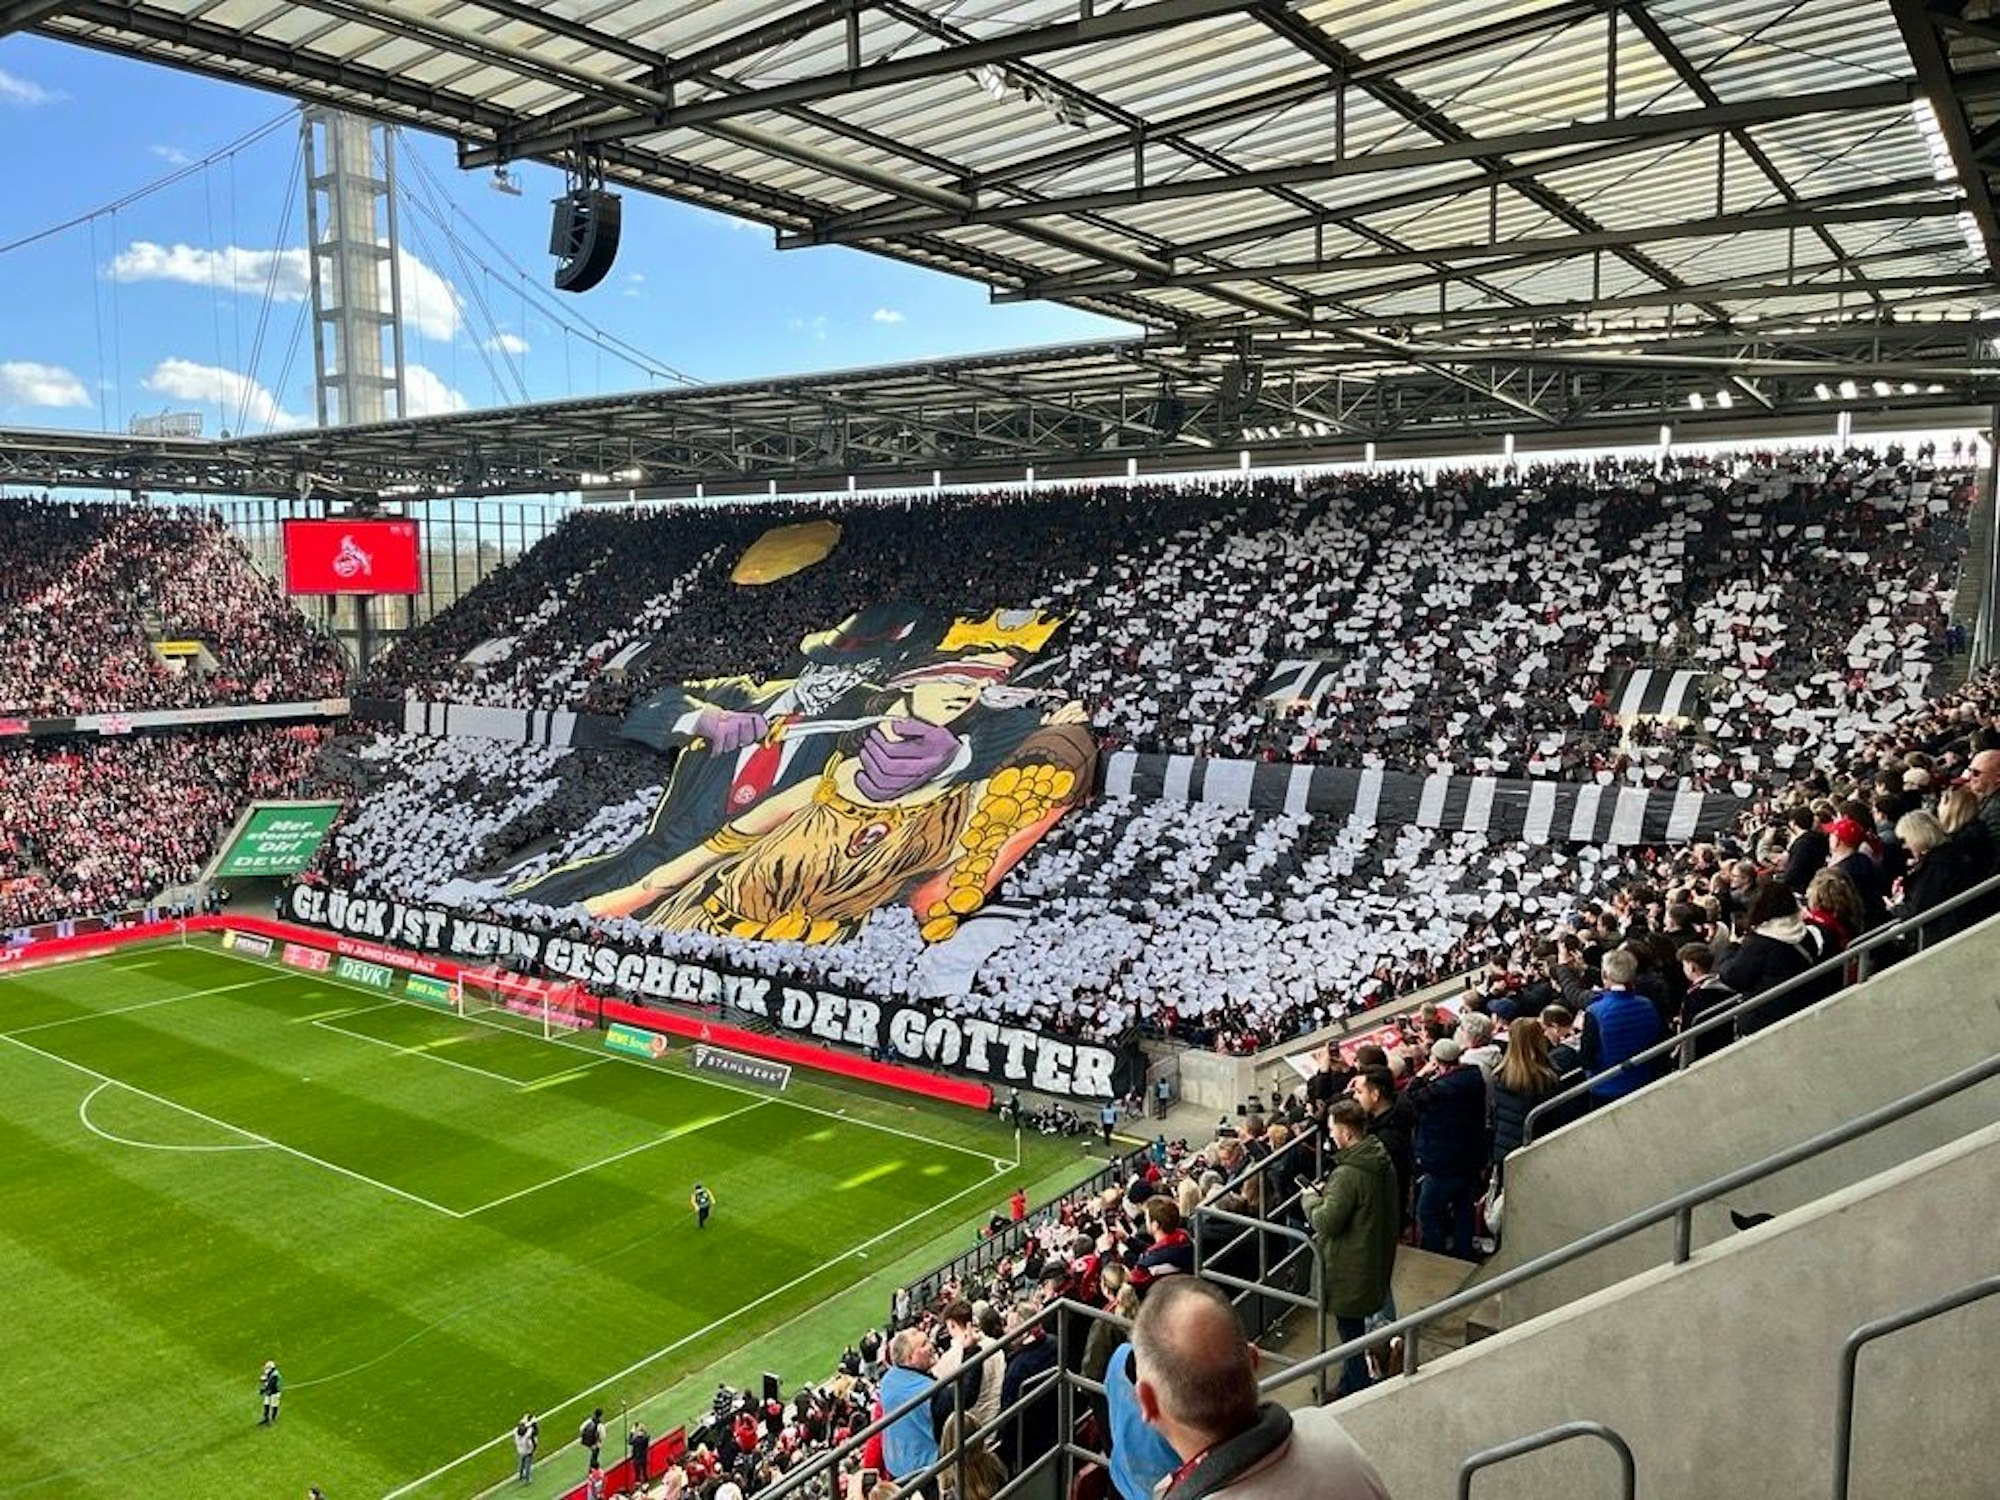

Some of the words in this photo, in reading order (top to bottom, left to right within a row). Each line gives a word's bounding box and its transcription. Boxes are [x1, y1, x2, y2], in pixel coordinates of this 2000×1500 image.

[233, 855, 304, 866] DEVK
[341, 962, 384, 988] DEVK
[292, 884, 388, 937] GLÜCK
[385, 902, 447, 948] IST
[451, 919, 540, 959] KEIN
[544, 938, 771, 1016] GESCHENK
[781, 986, 882, 1047] DER
[889, 1006, 1116, 1097] GÖTTER
